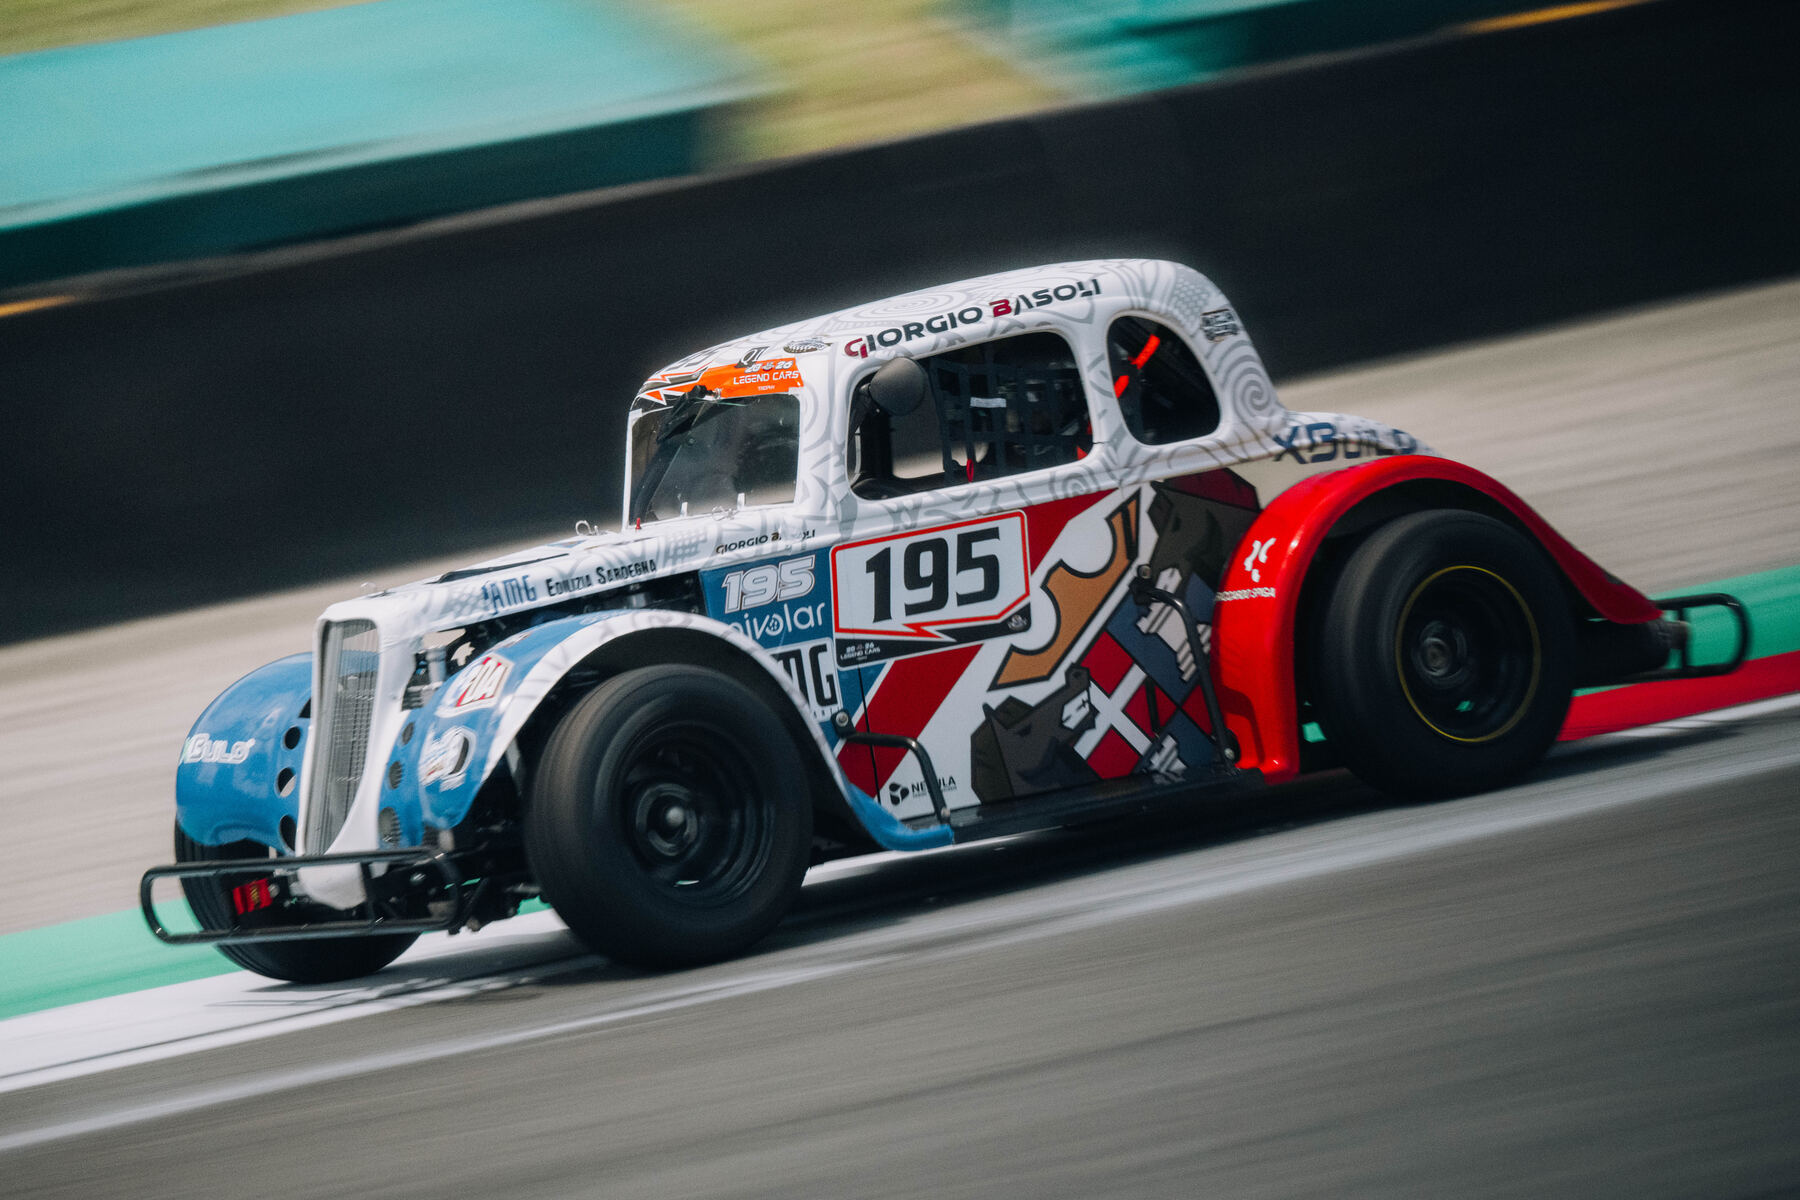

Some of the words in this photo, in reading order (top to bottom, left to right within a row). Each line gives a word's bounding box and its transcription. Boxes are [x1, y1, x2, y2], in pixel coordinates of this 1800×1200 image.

[844, 306, 983, 359] GIORGIO
[989, 278, 1101, 318] BASOLI
[733, 372, 770, 385] LEGEND
[772, 370, 799, 381] CARS
[716, 534, 768, 555] GIORGIO
[722, 554, 815, 614] 195
[865, 526, 1000, 624] 195
